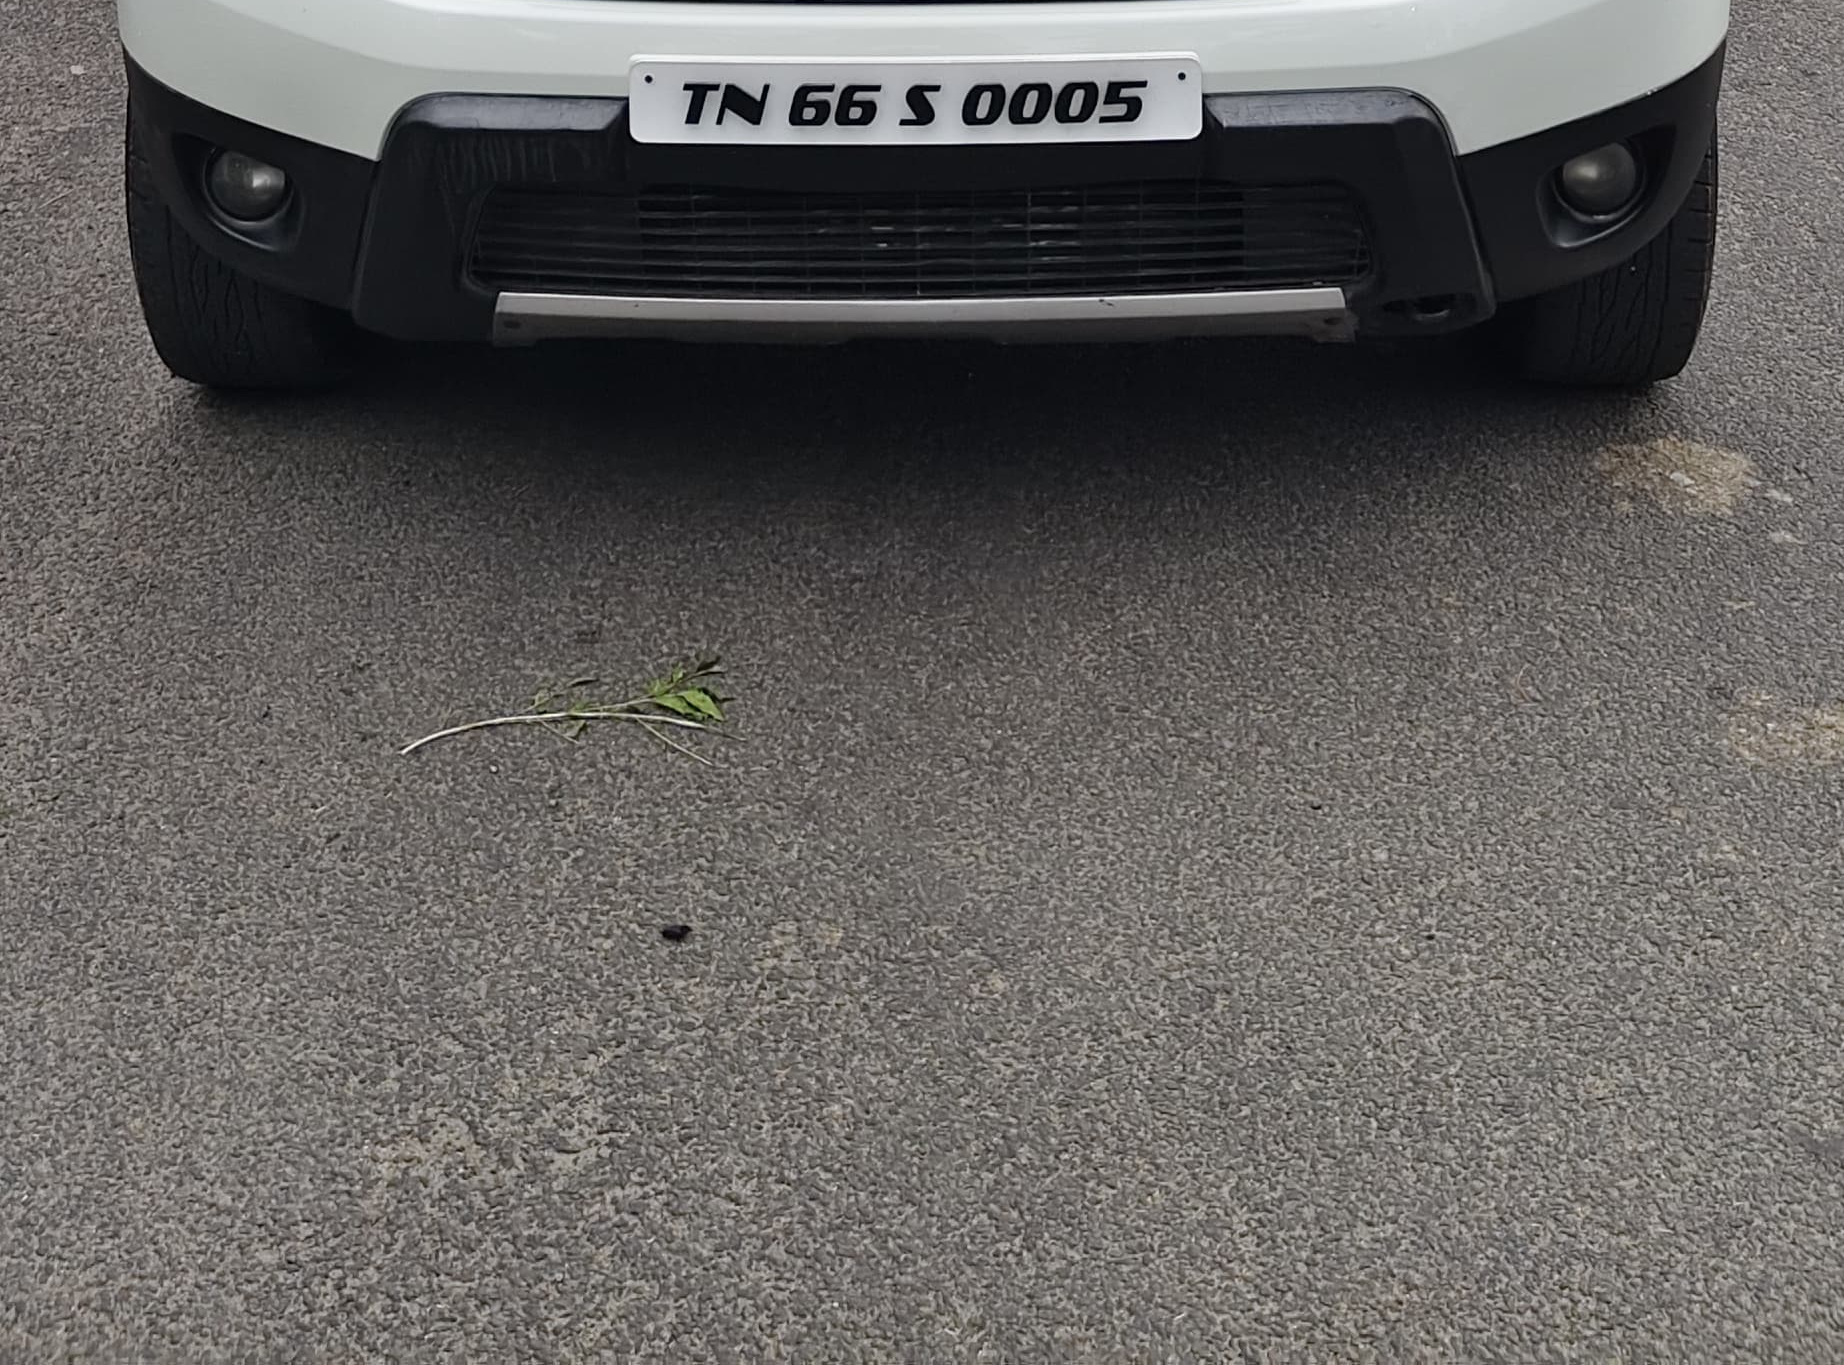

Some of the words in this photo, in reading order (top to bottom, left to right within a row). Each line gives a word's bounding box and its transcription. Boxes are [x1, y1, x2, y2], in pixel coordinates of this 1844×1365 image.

[682, 82, 770, 127] TN
[788, 83, 882, 127] 66
[898, 83, 942, 127] S
[960, 80, 1149, 127] 0005
